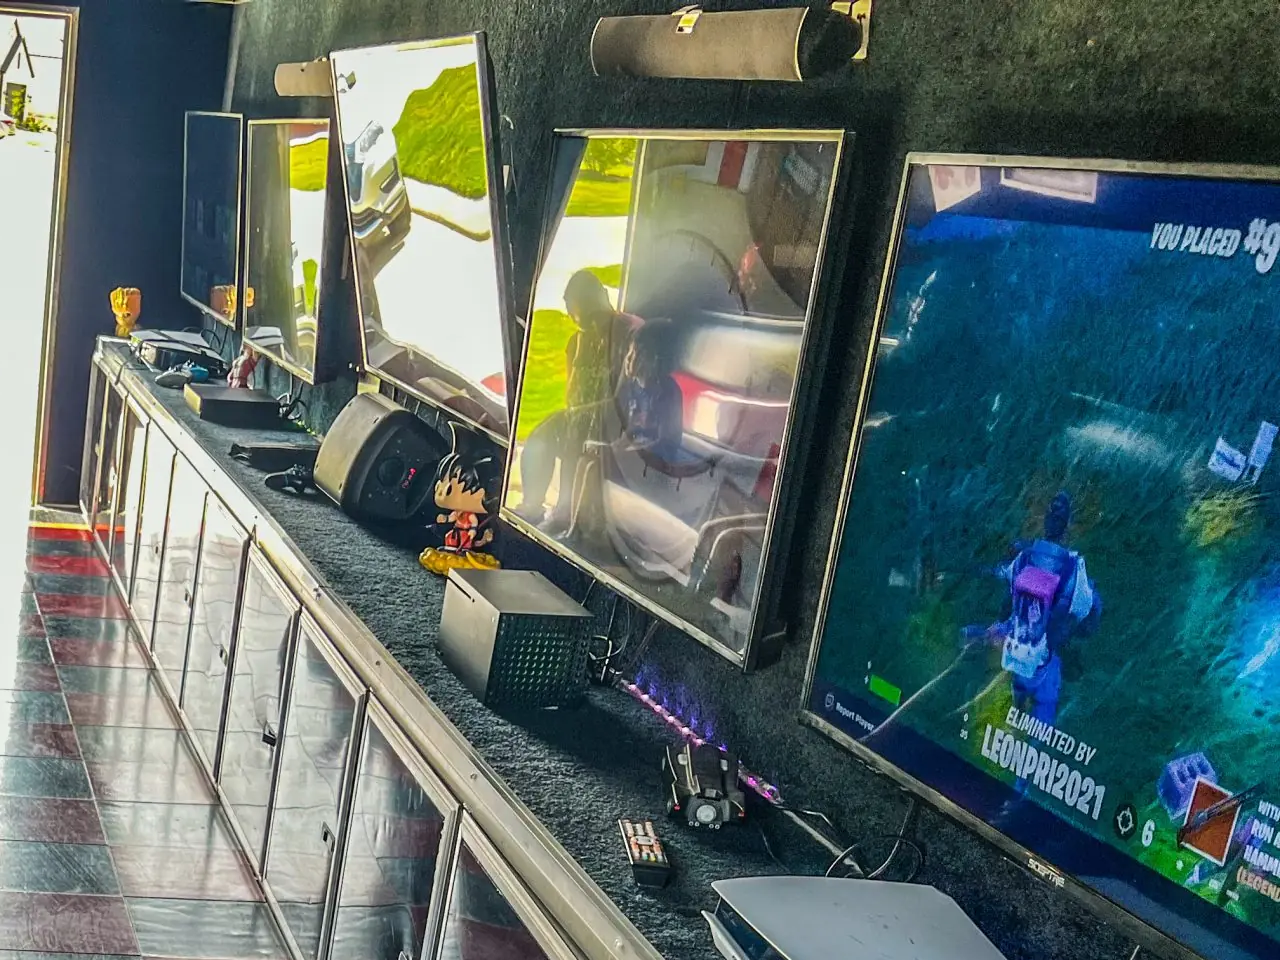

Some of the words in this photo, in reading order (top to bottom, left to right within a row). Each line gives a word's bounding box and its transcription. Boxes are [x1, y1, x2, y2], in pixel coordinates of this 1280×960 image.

[1150, 222, 1184, 251] YOU
[1179, 225, 1242, 258] PLACED
[1005, 705, 1075, 755] ELIMINATED
[1074, 741, 1097, 766] BY
[981, 723, 1106, 820] LEONPRI2021
[1141, 818, 1156, 847] 6
[1027, 858, 1065, 888] SCEPTRE
